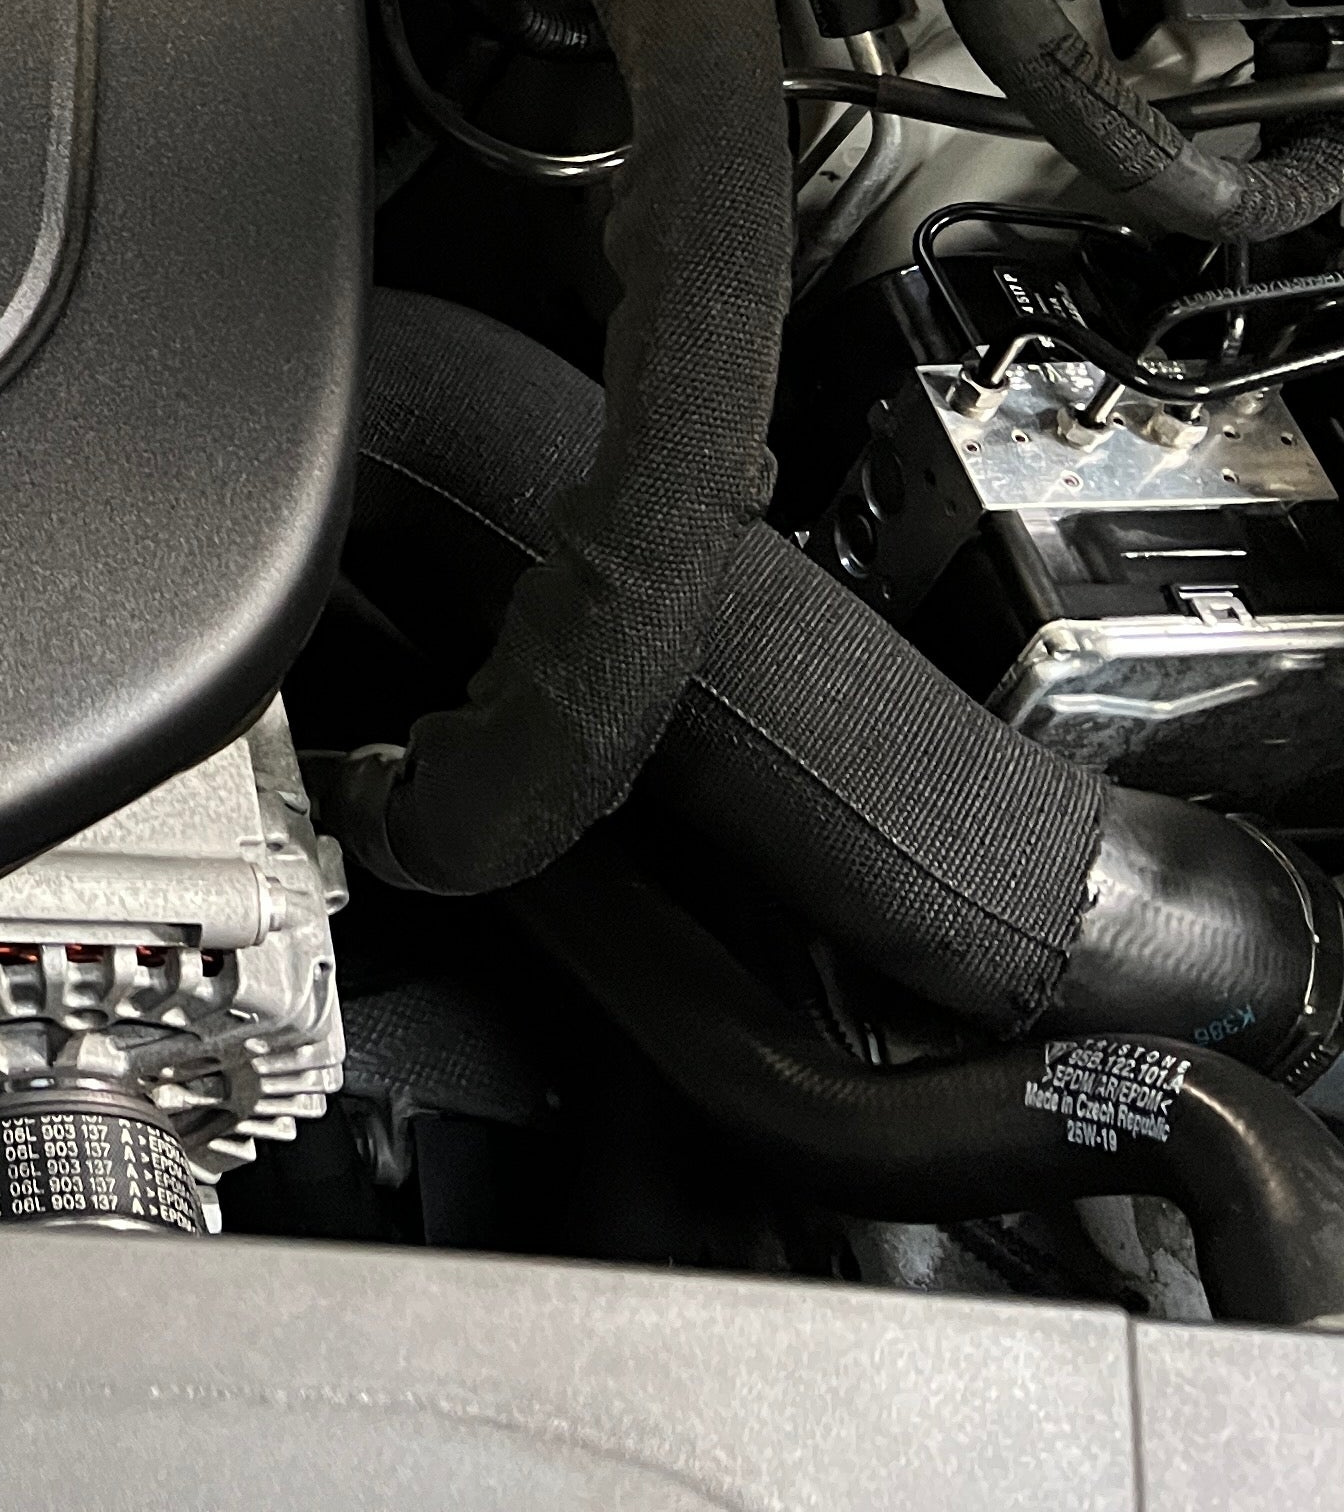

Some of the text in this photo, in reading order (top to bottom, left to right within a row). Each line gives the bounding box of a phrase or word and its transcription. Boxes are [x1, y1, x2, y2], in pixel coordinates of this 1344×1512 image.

[1025, 1081, 1170, 1143] Made in Czech Republic
[3, 1125, 37, 1144] 06L
[41, 1124, 76, 1140] 903
[81, 1124, 108, 1141] 137
[121, 1128, 134, 1145] A
[1067, 1119, 1118, 1152] 25W-19
[5, 1144, 40, 1162] 06L
[44, 1140, 78, 1158] 903
[84, 1141, 111, 1158] 137
[124, 1145, 136, 1163] A
[8, 1161, 42, 1179] 06L
[47, 1159, 81, 1175] 903
[85, 1159, 112, 1175] 137
[127, 1163, 139, 1179] A
[10, 1178, 45, 1197] 06L
[49, 1176, 83, 1193] 903
[89, 1177, 116, 1193] 137
[129, 1181, 141, 1198] A
[12, 1196, 46, 1215] 06L
[51, 1194, 86, 1210] 903
[90, 1194, 118, 1211] 137
[132, 1197, 145, 1215] A
